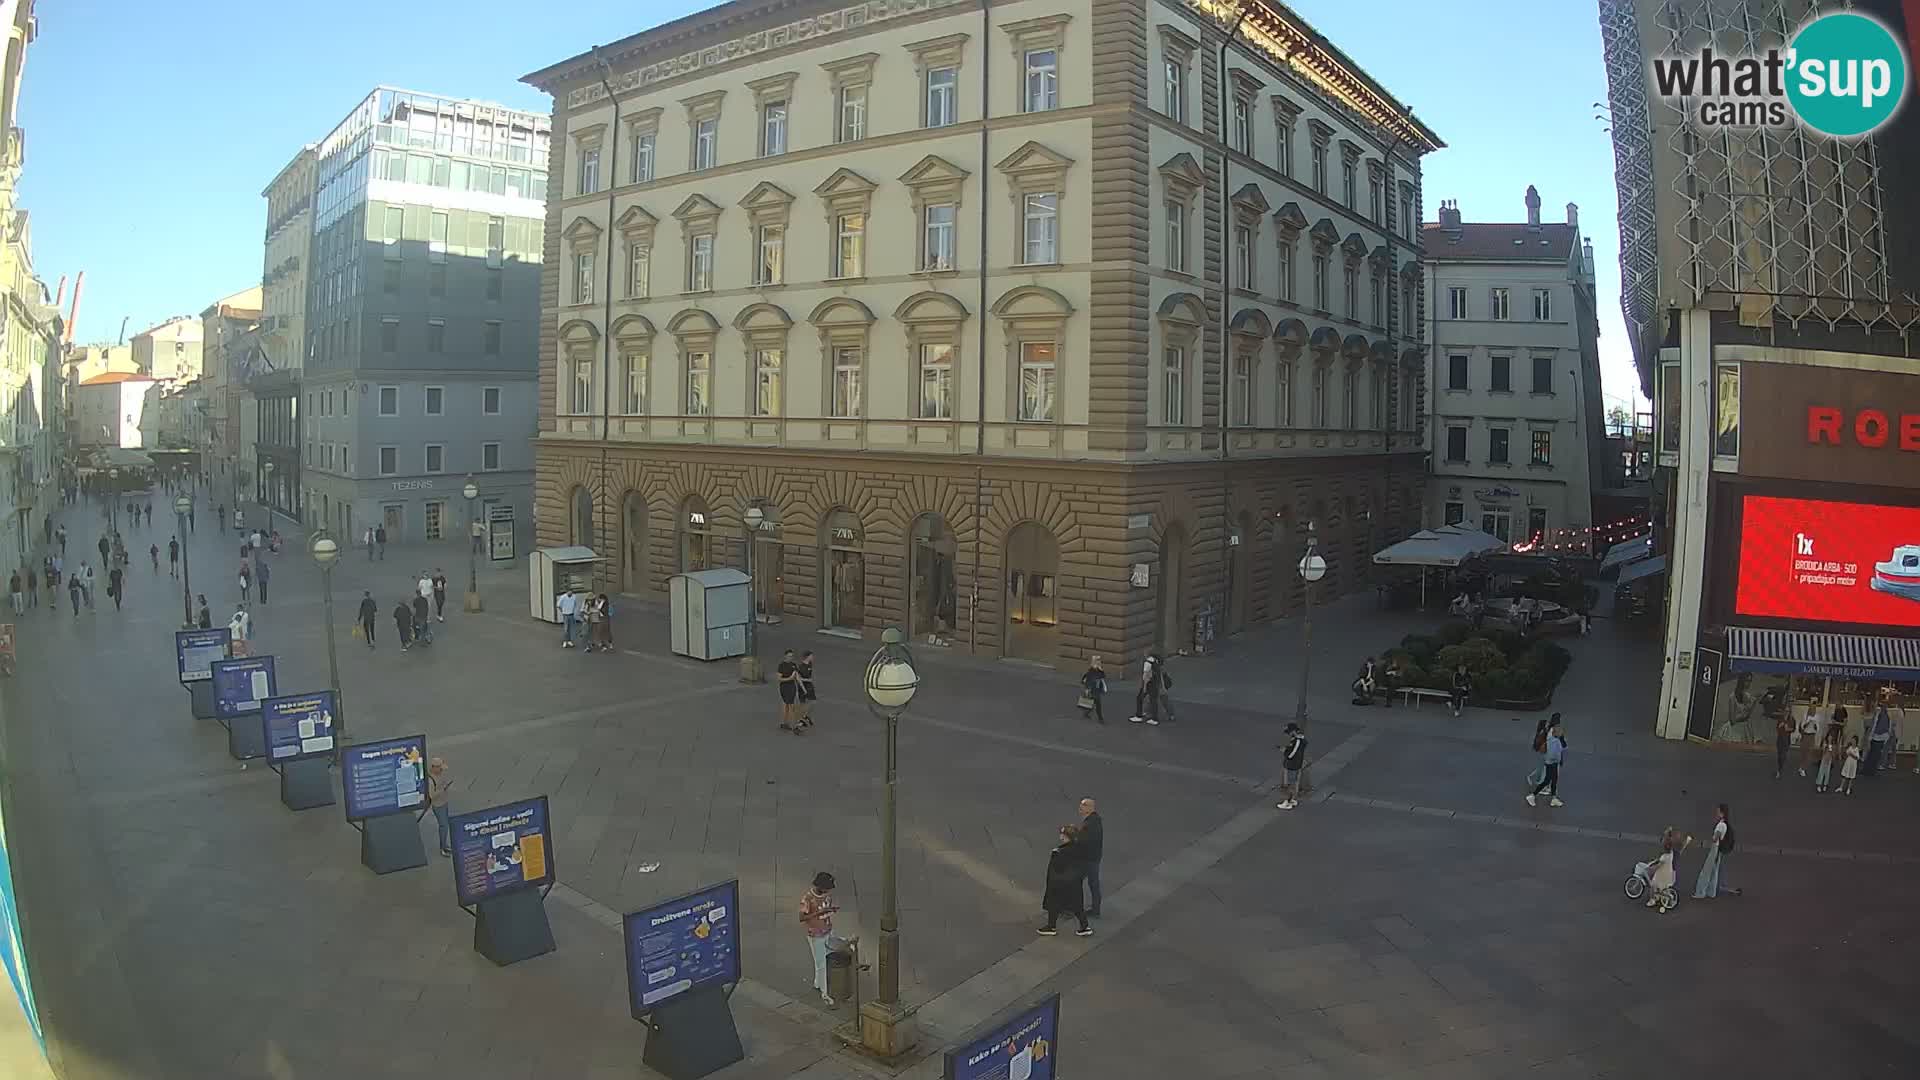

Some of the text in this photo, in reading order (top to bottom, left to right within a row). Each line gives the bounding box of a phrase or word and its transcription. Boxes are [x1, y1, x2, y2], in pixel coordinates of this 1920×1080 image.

[392, 480, 433, 490] TEZENIS
[1797, 533, 1814, 555] 1x
[1795, 560, 1822, 571] BRODICA
[1844, 563, 1858, 574] 500
[651, 909, 691, 926] Društvene
[968, 1050, 990, 1067] Kako
[991, 1044, 1001, 1054] se
